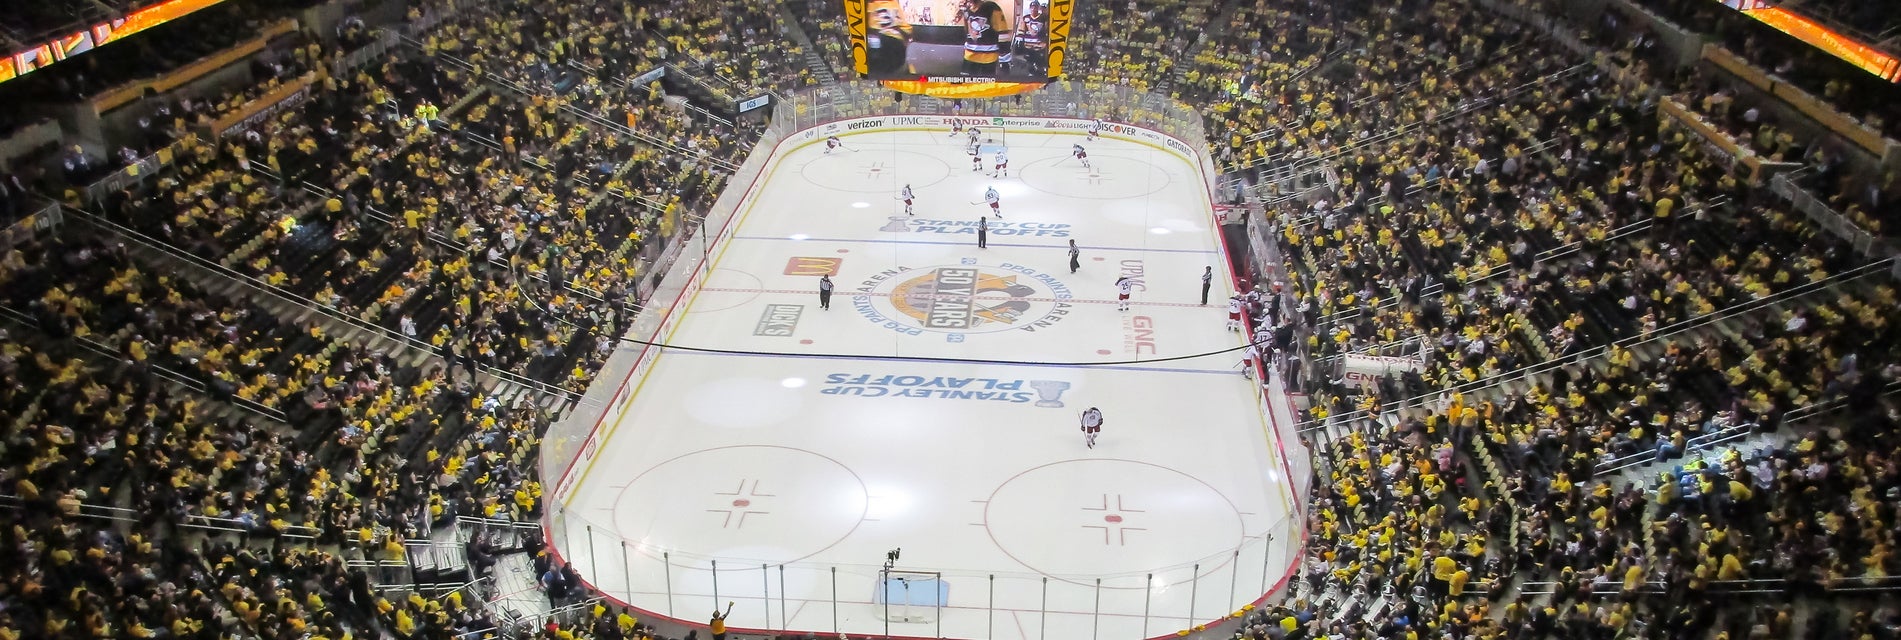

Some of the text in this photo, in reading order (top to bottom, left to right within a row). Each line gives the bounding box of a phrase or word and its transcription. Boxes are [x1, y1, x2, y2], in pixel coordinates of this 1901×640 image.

[847, 0, 867, 65] PMC
[1048, 0, 1071, 68] PMC
[847, 118, 882, 130] verizon
[892, 116, 924, 126] UPMC
[943, 118, 990, 126] HNDA
[910, 218, 1071, 230] STANEY CUP
[915, 226, 1070, 237] PLAOFFS
[939, 269, 971, 285] 50
[852, 265, 923, 336] PPG PAINTS ARENA
[999, 262, 1073, 333] PPG PAINTS ARENA
[931, 287, 969, 328] YEARS
[1132, 316, 1156, 355] GNC
[825, 373, 1025, 390] PLAYOFFS
[820, 386, 1034, 403] STANLEY CUP
